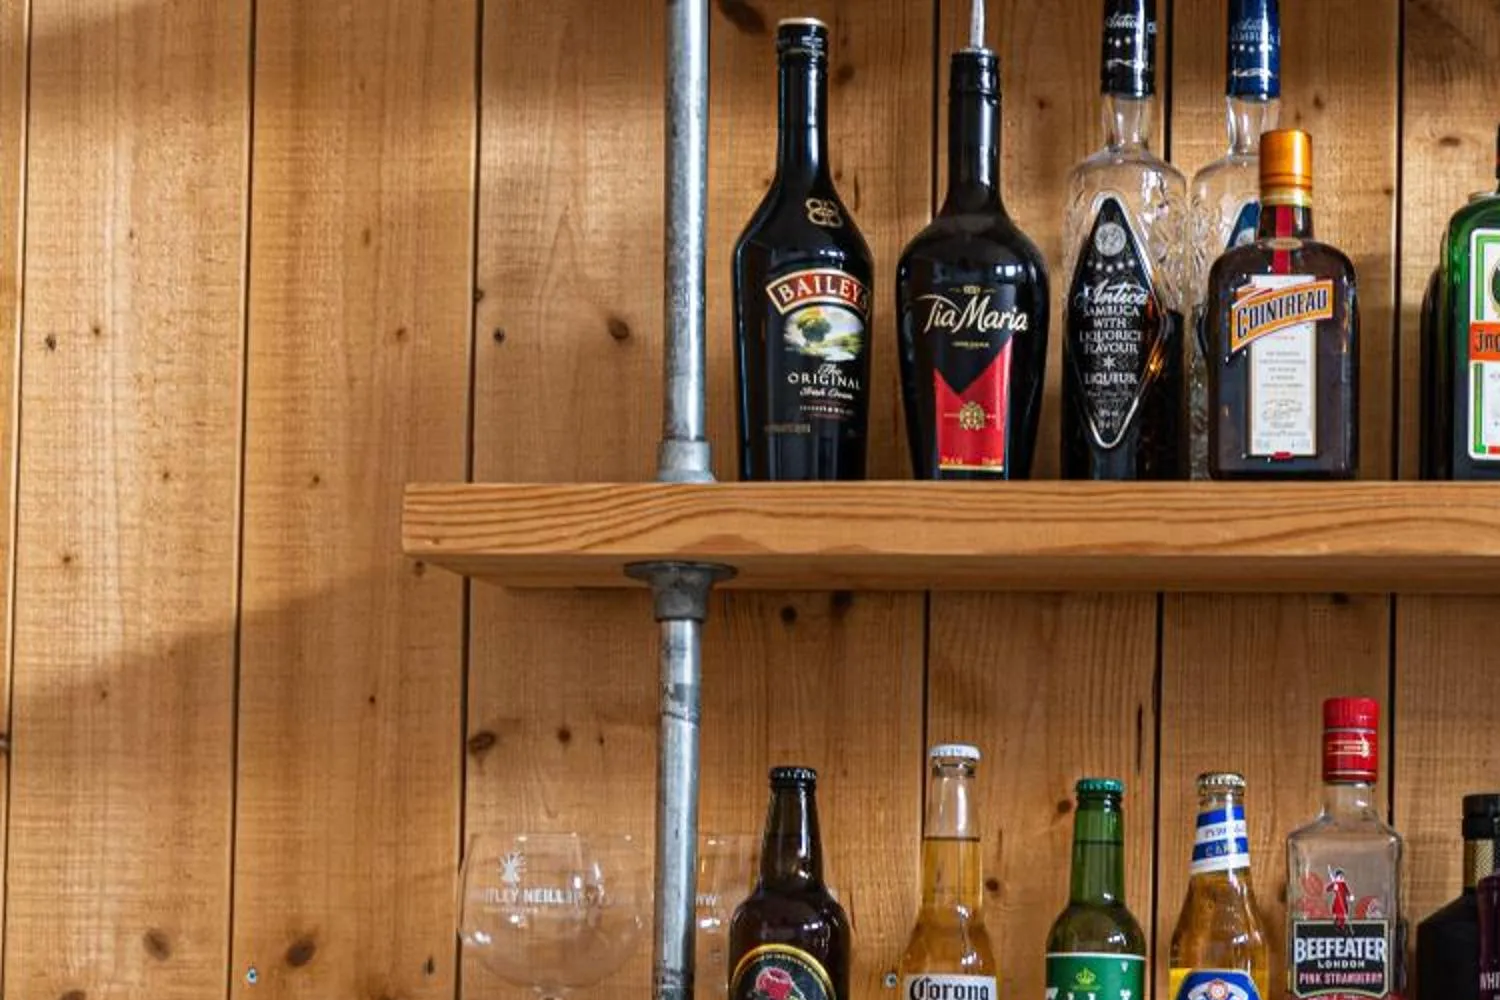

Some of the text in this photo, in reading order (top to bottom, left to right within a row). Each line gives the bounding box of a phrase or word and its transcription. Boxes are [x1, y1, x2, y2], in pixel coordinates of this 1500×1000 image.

[917, 293, 1029, 334] Tia Maria
[1092, 317, 1128, 330] WITH
[1235, 287, 1330, 340] COINTREAU
[787, 371, 861, 389] ORIGINAL
[1293, 936, 1387, 963] BEEFEATER
